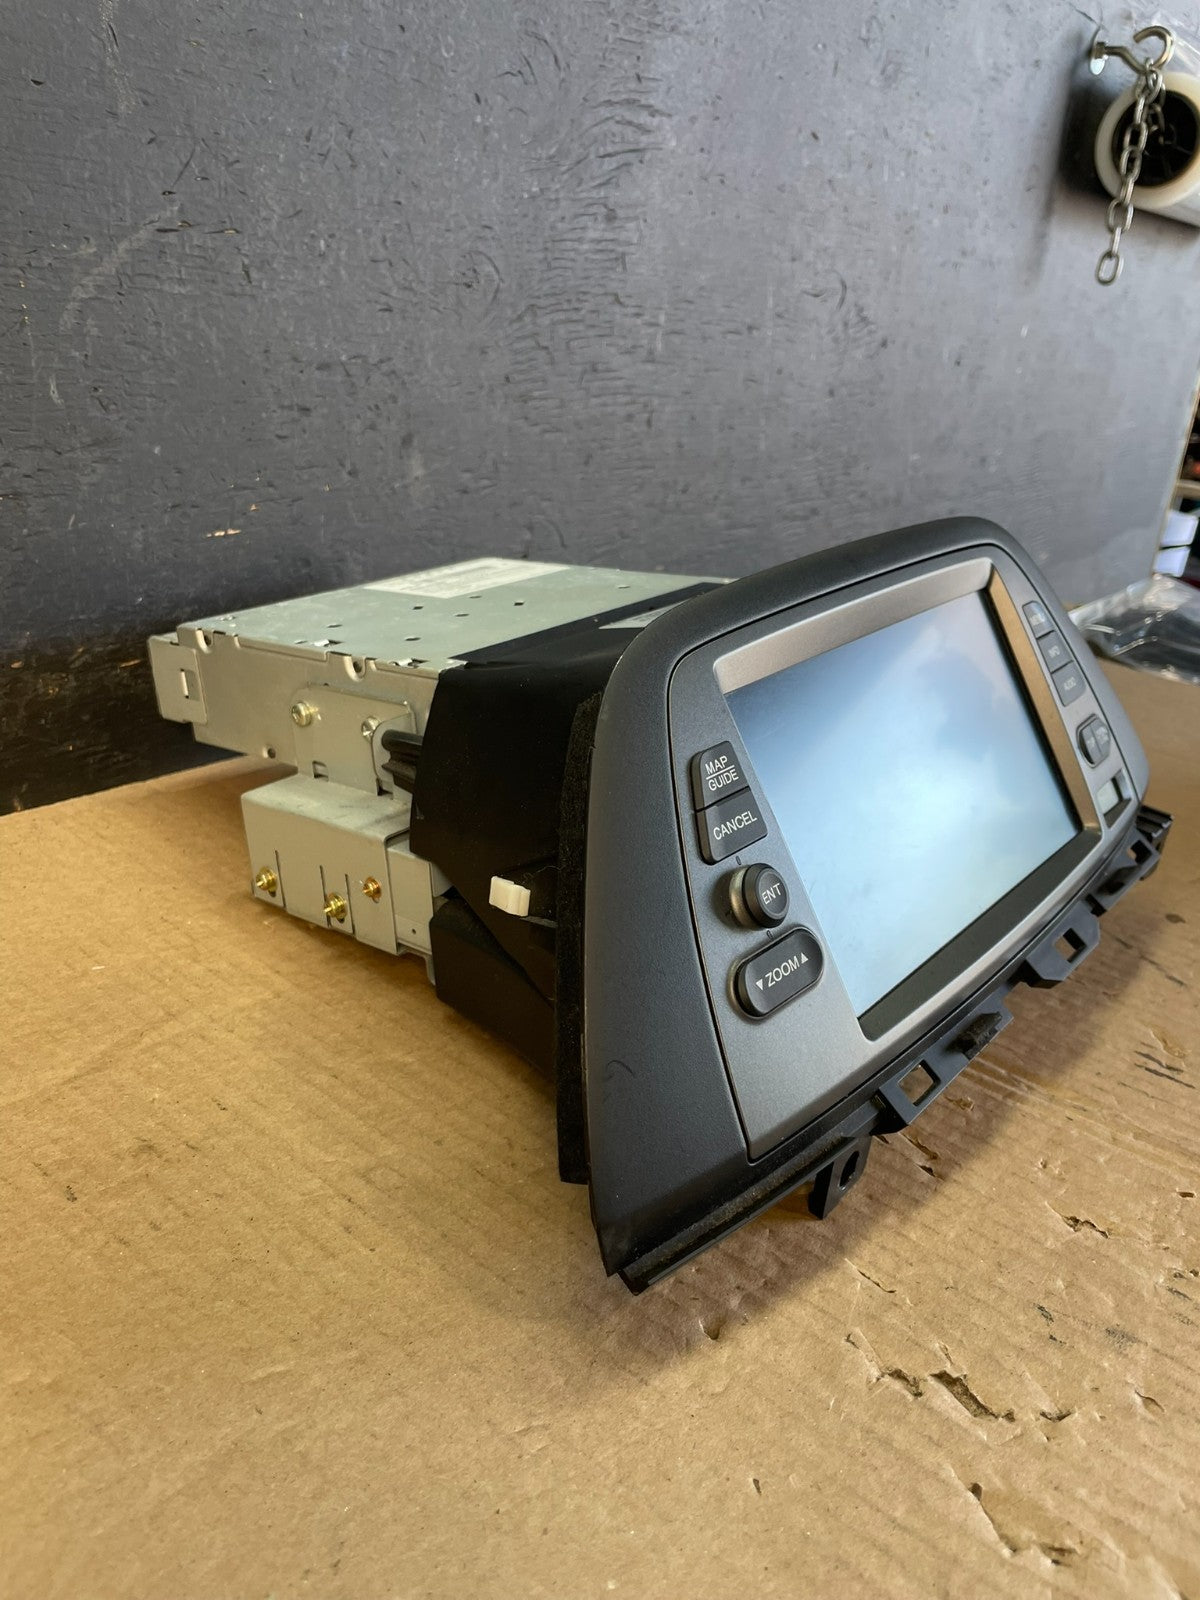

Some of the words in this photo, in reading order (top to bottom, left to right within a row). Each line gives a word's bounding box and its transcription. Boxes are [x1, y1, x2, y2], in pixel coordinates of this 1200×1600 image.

[705, 755, 728, 775] MAP
[708, 768, 739, 791] GUIDE
[713, 811, 757, 840] CANCEL
[761, 883, 781, 905] ENT
[765, 956, 800, 987] ZOOM
